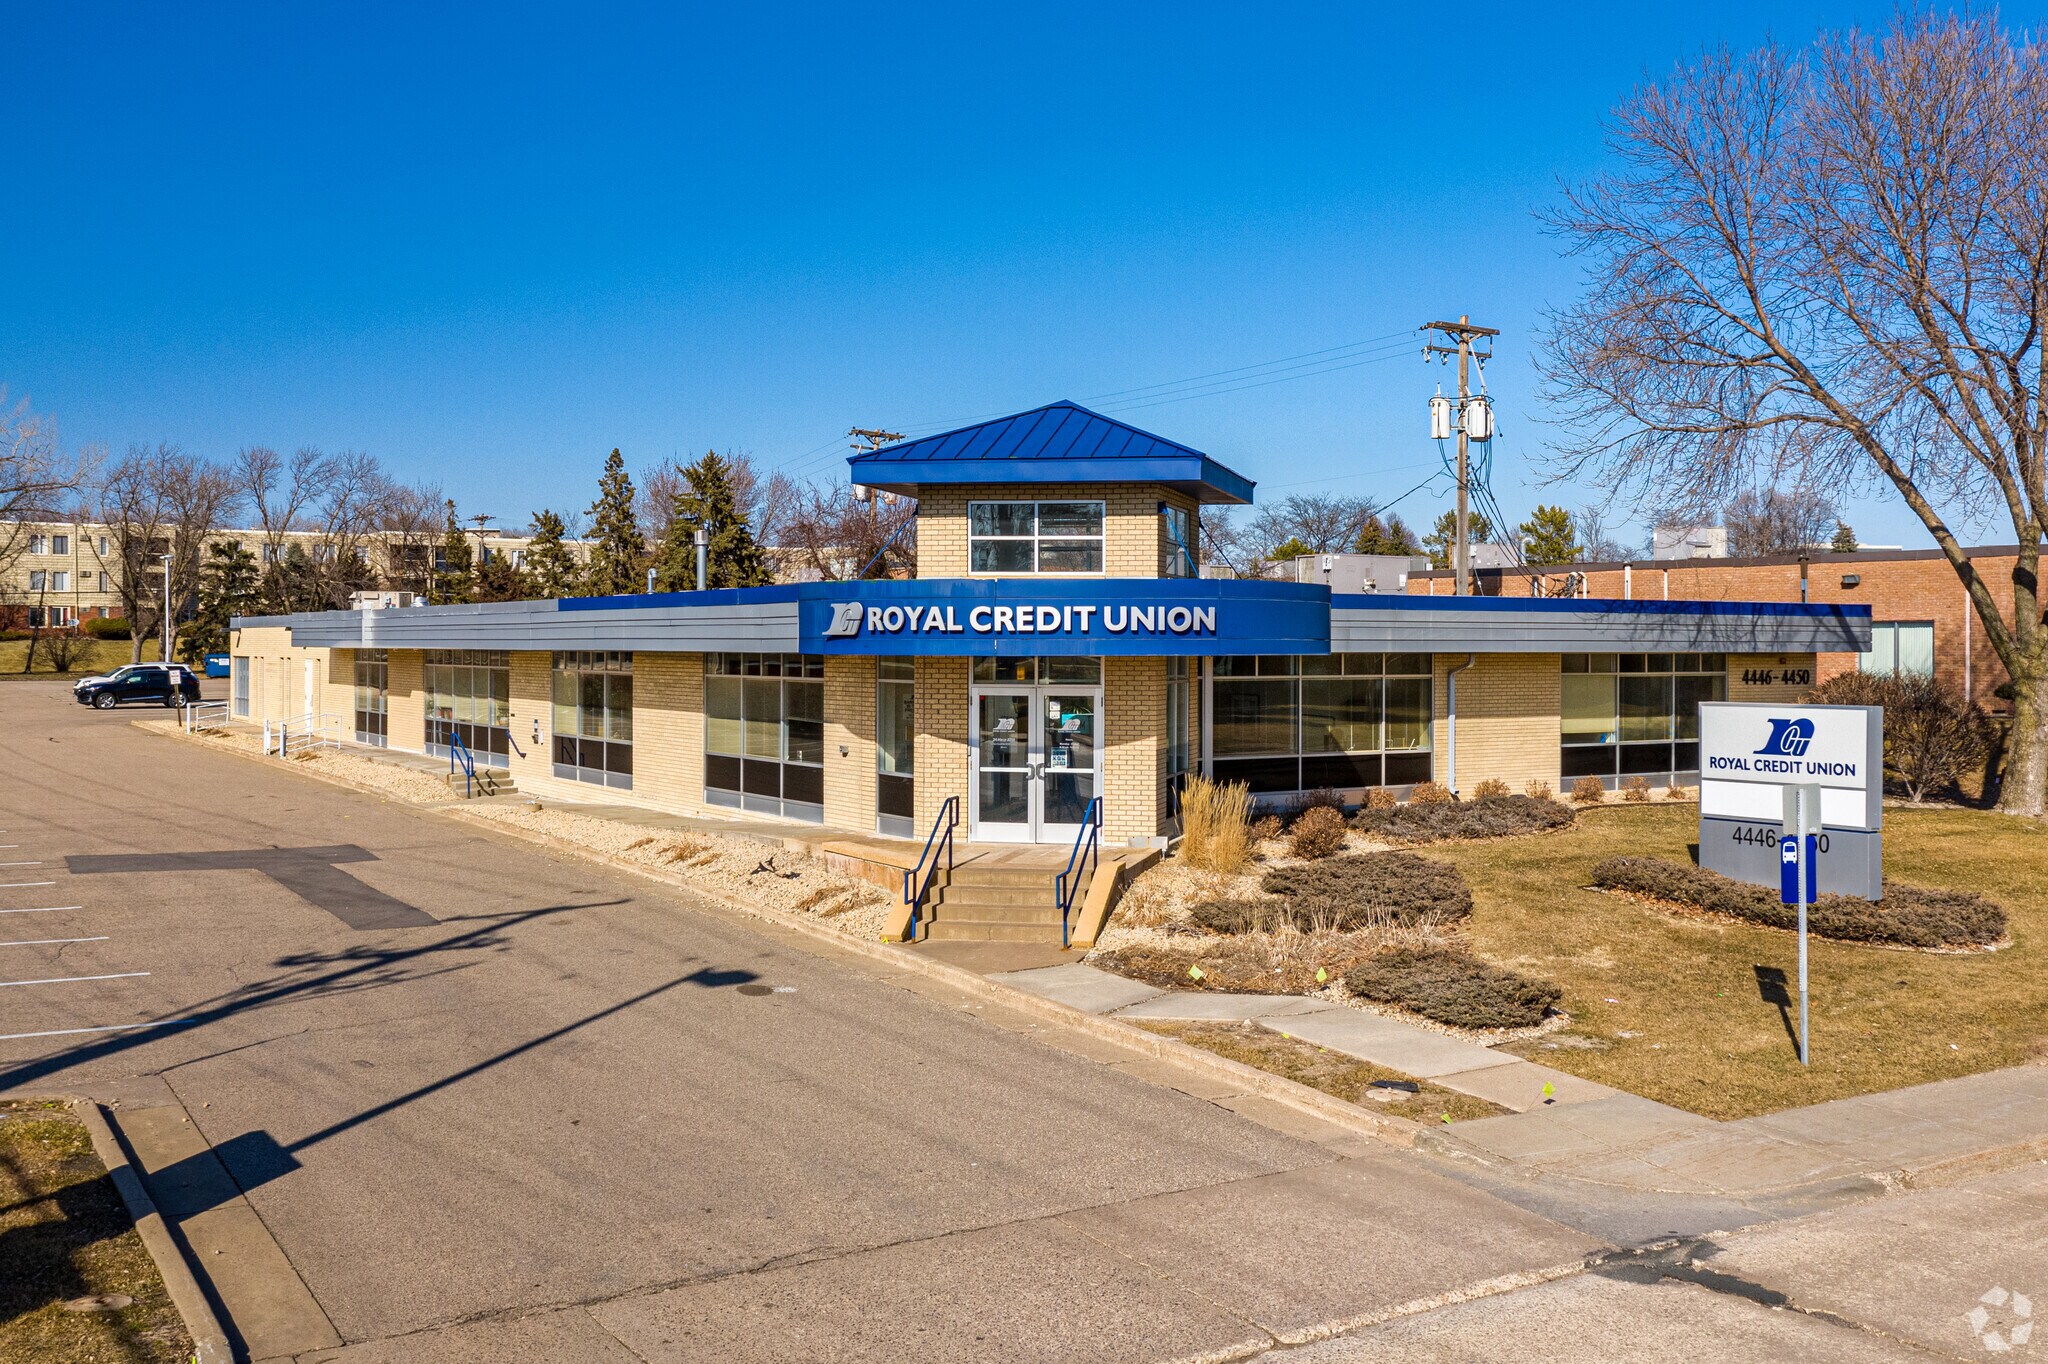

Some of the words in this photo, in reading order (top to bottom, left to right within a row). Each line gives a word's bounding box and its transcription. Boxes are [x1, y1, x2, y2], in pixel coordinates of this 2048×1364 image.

[867, 606, 963, 632] ROYAL
[969, 605, 1096, 632] CREDIT
[1103, 605, 1216, 632] UNION
[1709, 756, 1751, 771] ROYAL
[1753, 759, 1803, 774] CREDIT
[1806, 762, 1856, 777] UNION
